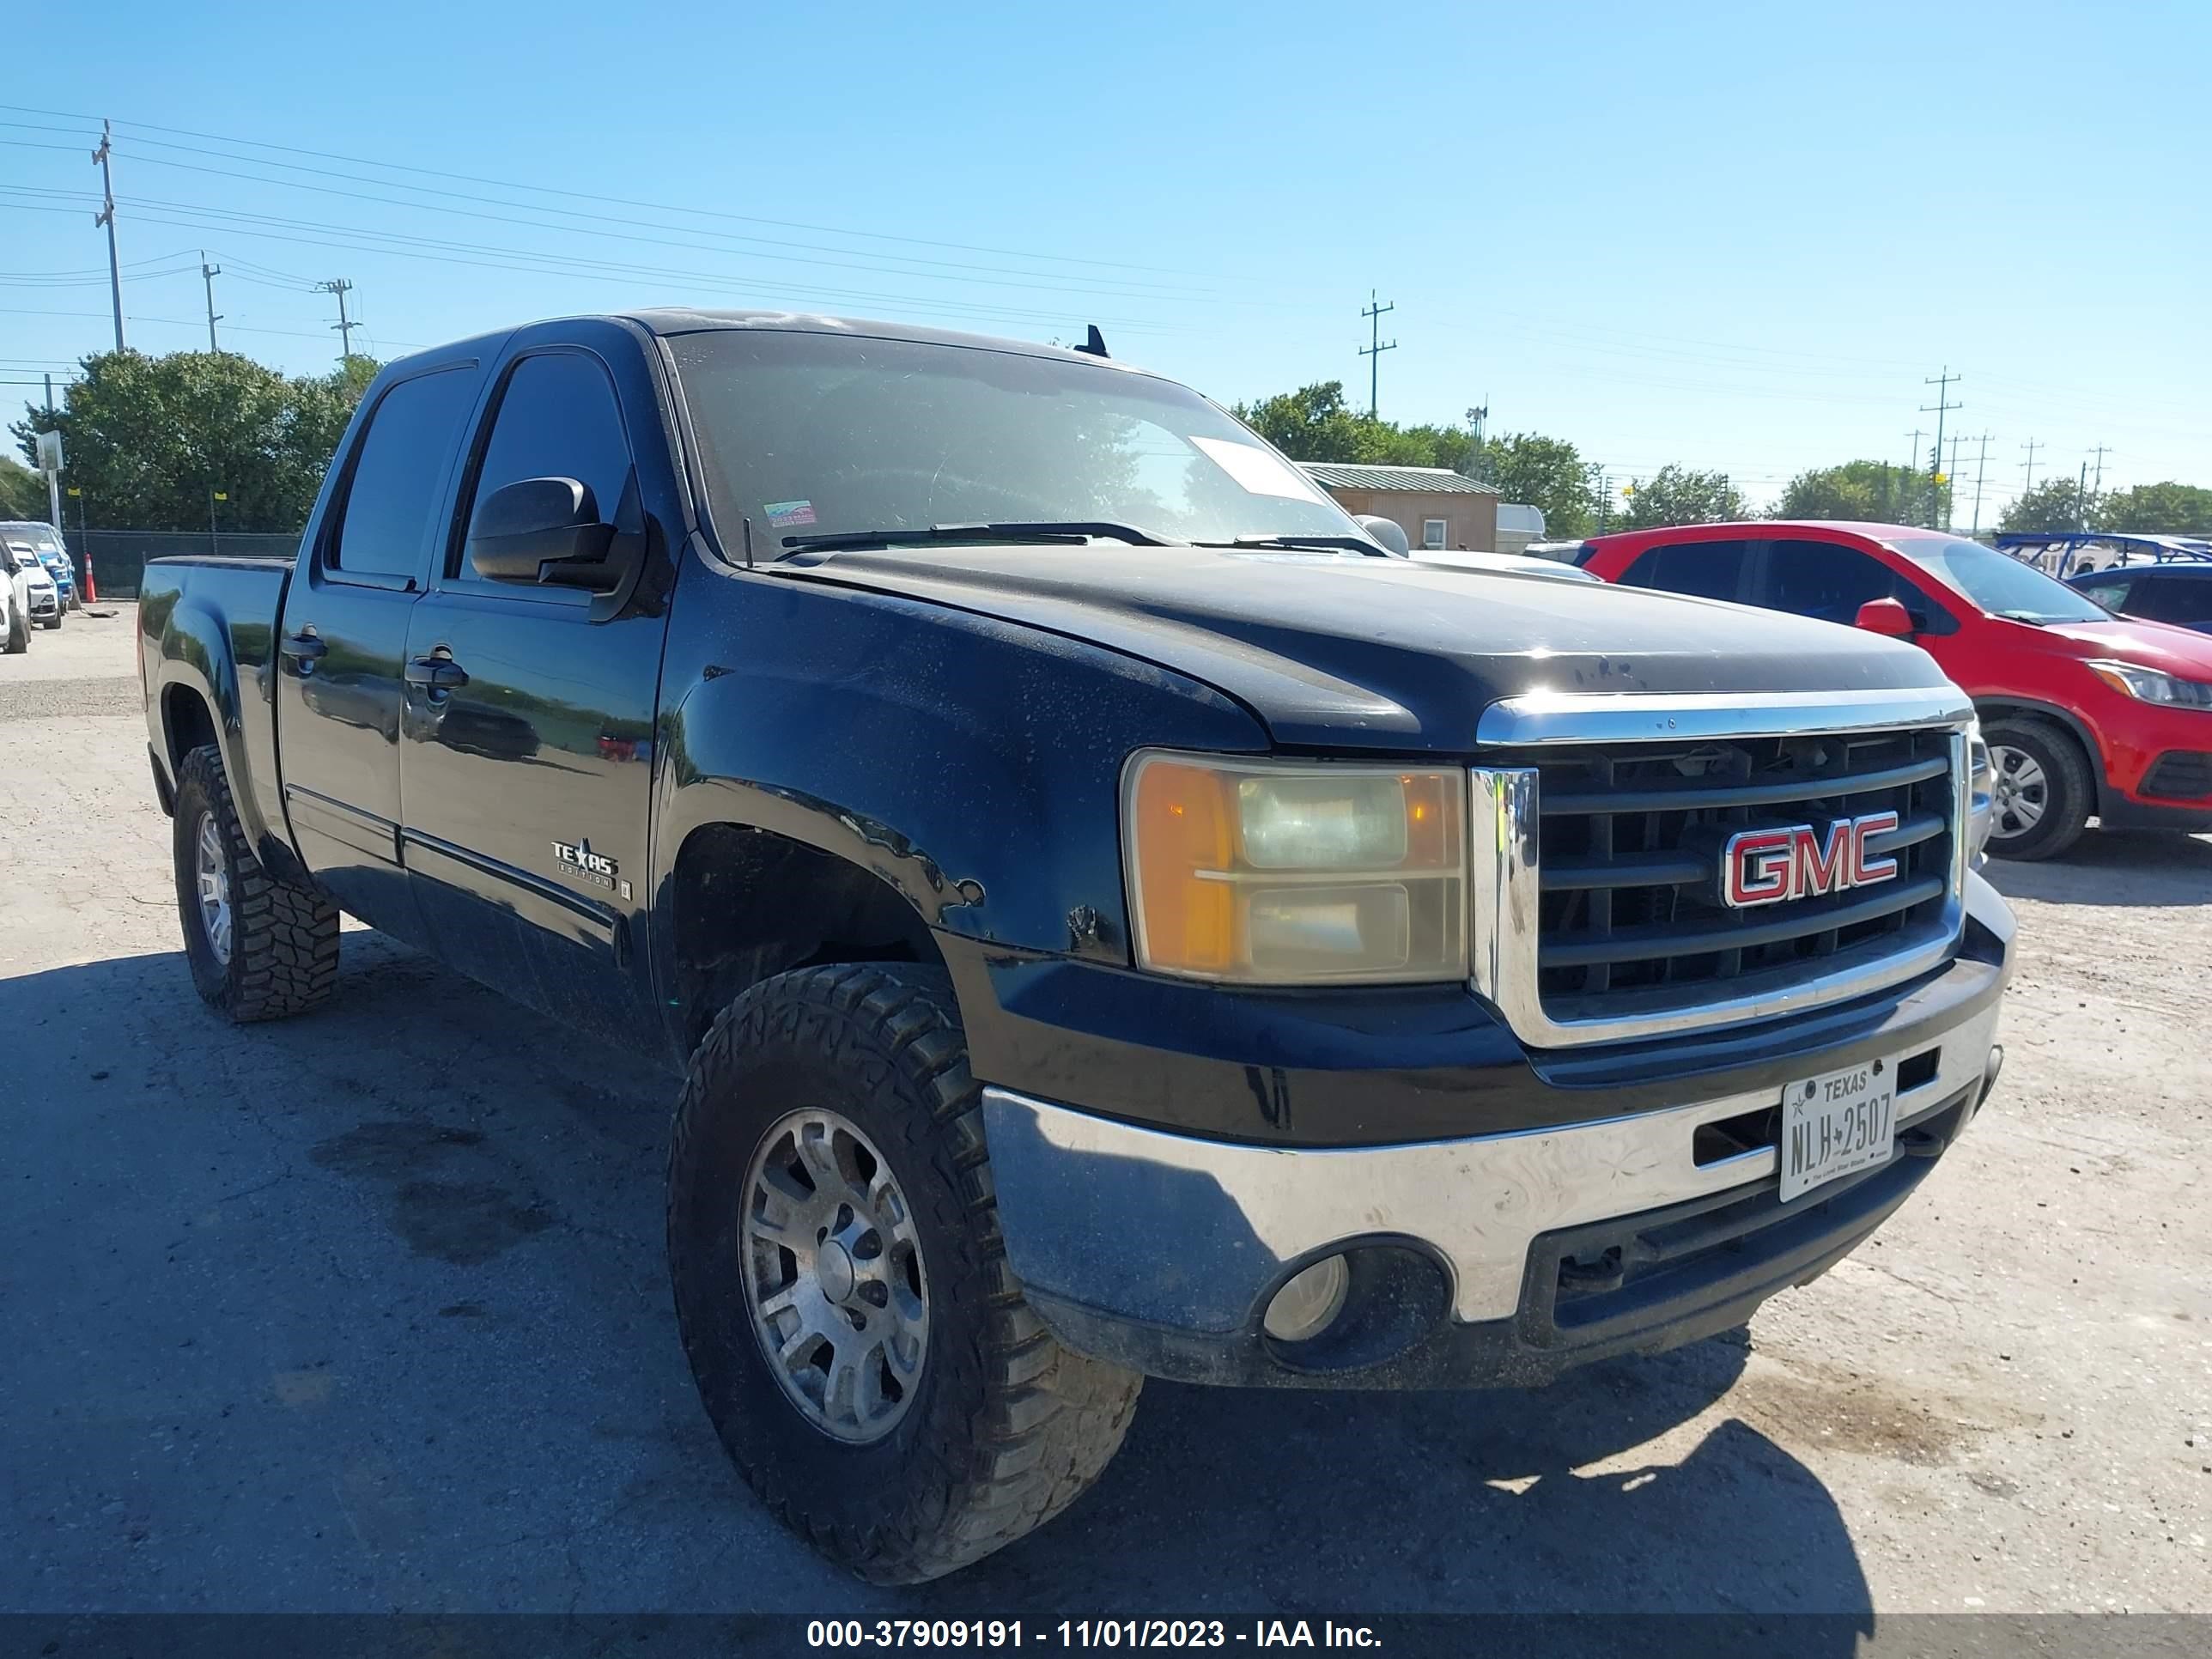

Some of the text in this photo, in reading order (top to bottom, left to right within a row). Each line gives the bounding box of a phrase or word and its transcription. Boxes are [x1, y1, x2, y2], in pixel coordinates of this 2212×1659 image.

[550, 838, 612, 875] TEXAS
[1724, 811, 1899, 907] GMC
[559, 864, 610, 888] EDITION
[1824, 1071, 1867, 1103] TEXAS
